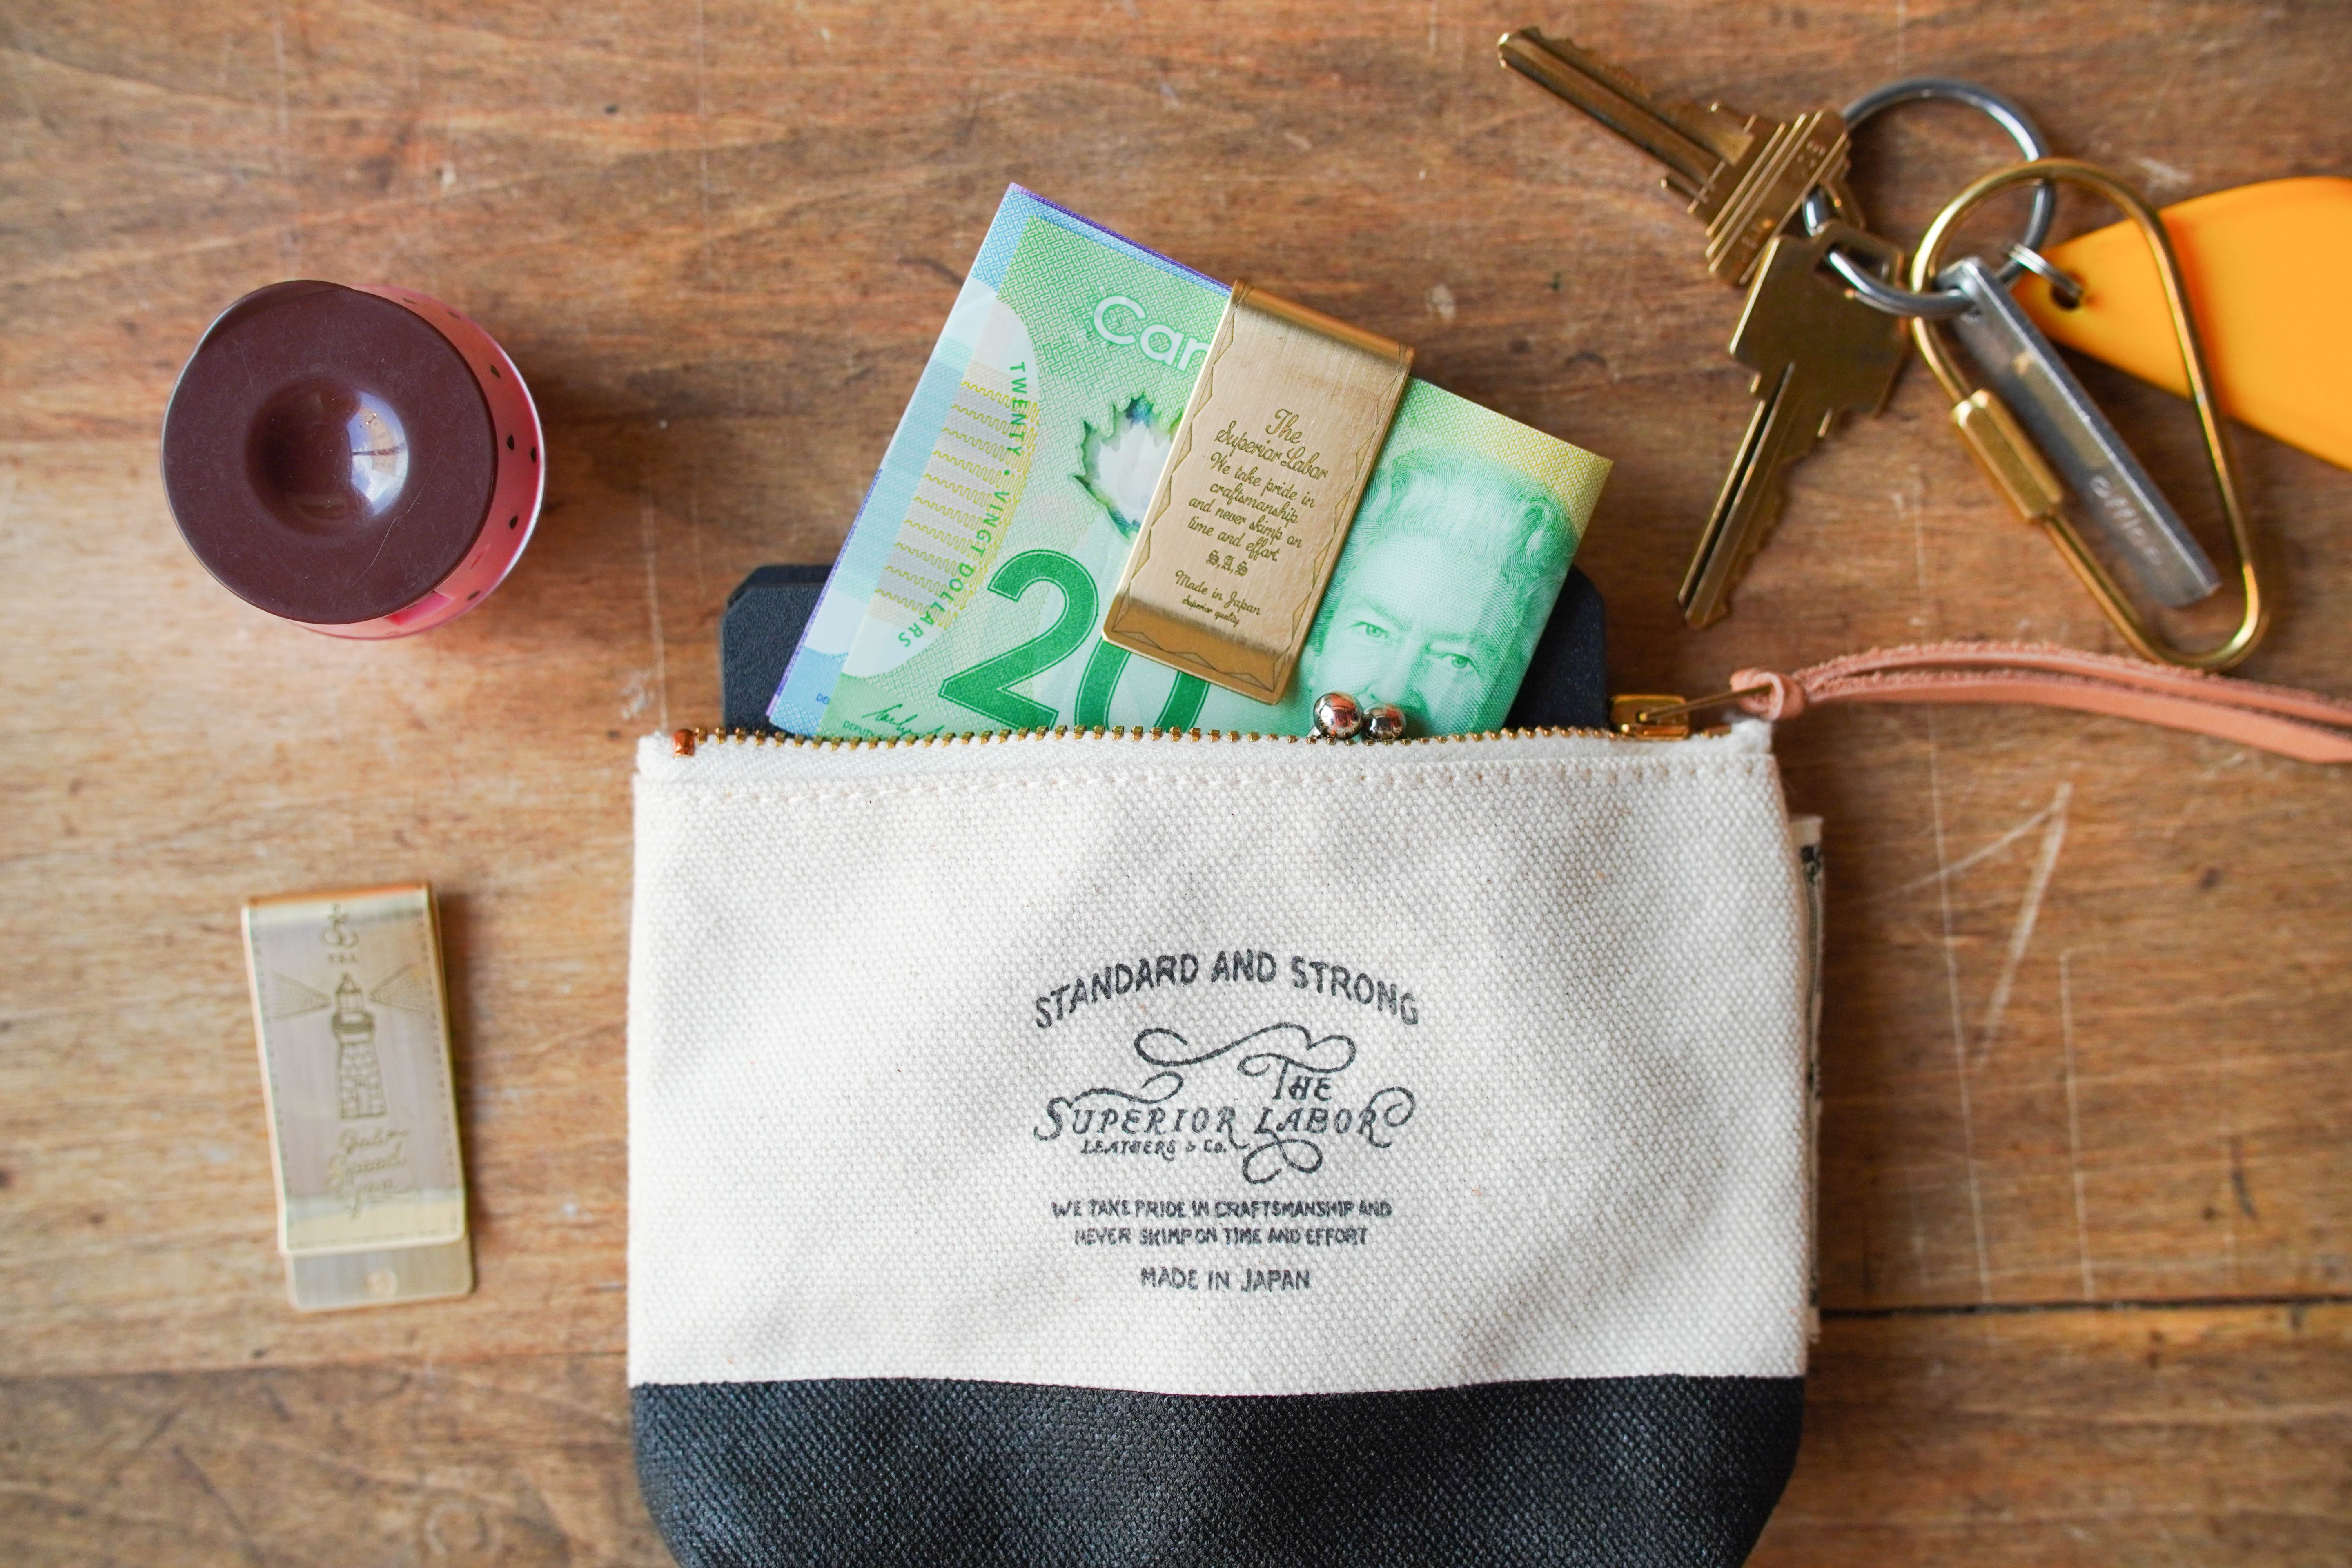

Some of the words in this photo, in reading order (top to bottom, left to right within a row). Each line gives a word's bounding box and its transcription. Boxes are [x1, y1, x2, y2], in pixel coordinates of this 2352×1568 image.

[1009, 361, 1028, 458] TWENTY
[1266, 408, 1303, 444] The
[1214, 420, 1283, 462] Superior
[1280, 447, 1329, 480] Labor
[1211, 452, 1231, 474] We
[1234, 466, 1262, 486] take
[1260, 477, 1298, 501] pride
[1301, 491, 1315, 508] in
[970, 491, 1010, 557] VINGT
[1189, 497, 1216, 513] and
[1215, 508, 1247, 526] never
[1248, 514, 1283, 545] skimp
[1287, 535, 1302, 548] on
[1209, 483, 1298, 528] craftsmanship
[1187, 516, 1214, 536] time
[1217, 532, 1246, 548] and
[1245, 536, 1281, 562] effort.
[898, 564, 974, 648] DOLLARS
[1175, 570, 1208, 595] Made
[1211, 588, 1223, 601] in
[1223, 591, 1261, 616] Japan
[1182, 595, 1213, 614] Superior
[1214, 611, 1240, 628] quality
[1036, 953, 1199, 1028] STANDARD
[1210, 949, 1277, 982] AND
[1290, 956, 1419, 1025] STRONG
[1034, 1097, 1241, 1143] SUPERIOR
[1051, 1200, 1082, 1218] WE
[1088, 1199, 1131, 1218] TAKE
[1135, 1199, 1187, 1218] PRIDE
[1192, 1200, 1209, 1217] IN
[1214, 1200, 1355, 1219] CRAFTSMANSHIP
[1359, 1199, 1392, 1218] AND
[1075, 1227, 1131, 1246] NEVER
[1139, 1227, 1192, 1247] SKIMP
[1195, 1227, 1218, 1244] ON
[1223, 1227, 1262, 1245] TIME
[1267, 1227, 1301, 1245] AND
[1306, 1227, 1368, 1247] EFFORT
[1140, 1267, 1200, 1291] MADE
[1208, 1269, 1230, 1291] IN
[1240, 1268, 1310, 1293] JAPAN
